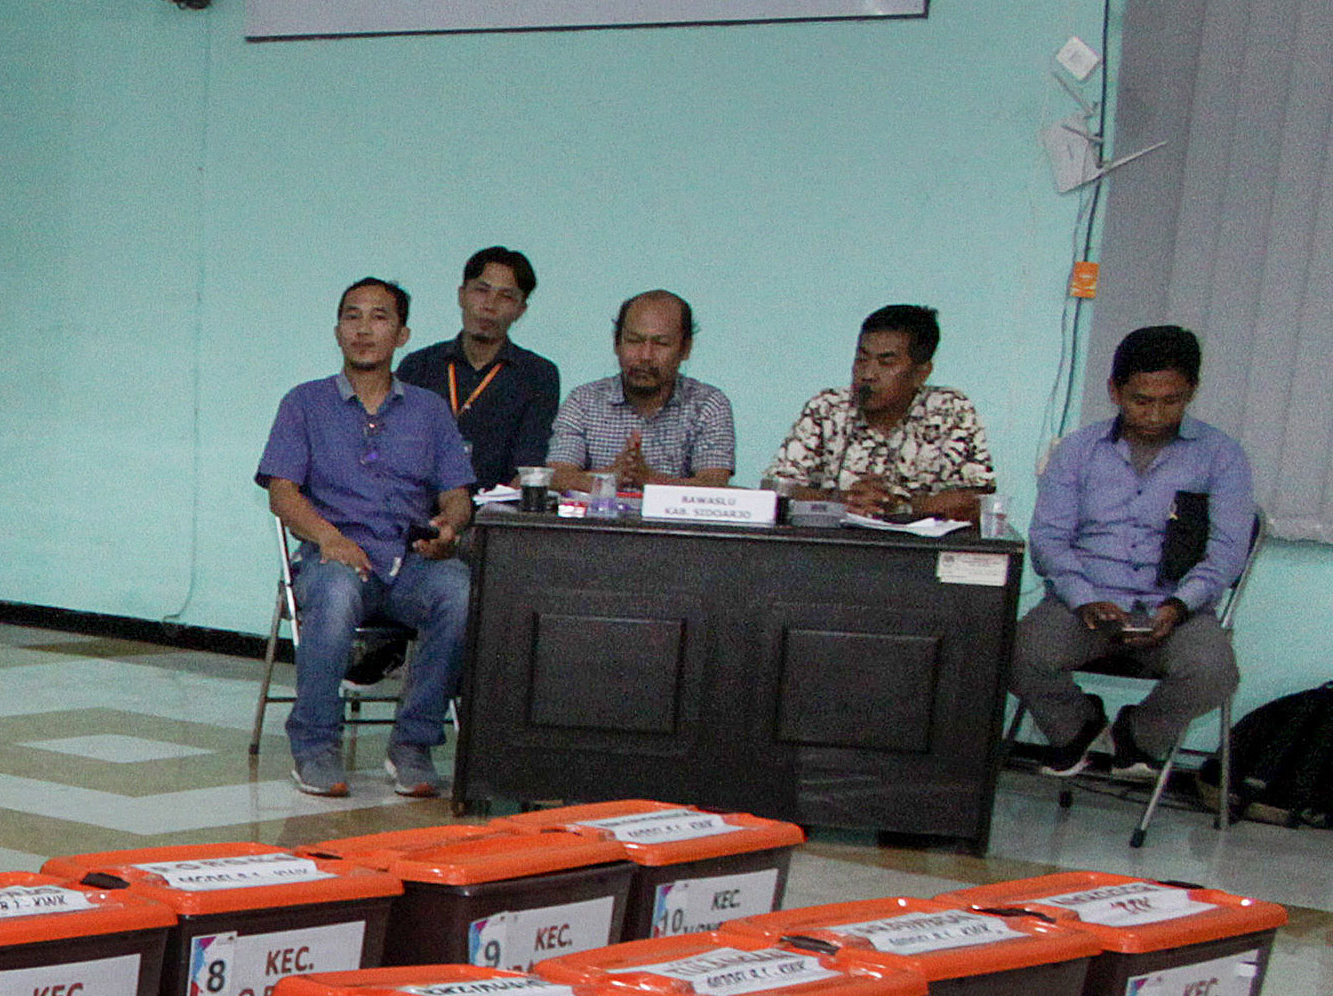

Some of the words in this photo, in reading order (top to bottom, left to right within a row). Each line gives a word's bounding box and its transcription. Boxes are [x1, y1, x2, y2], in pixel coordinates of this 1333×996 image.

[660, 907, 682, 934] 10
[535, 924, 573, 952] KEC.
[265, 946, 315, 976] KEC.
[485, 940, 501, 967] 9
[207, 960, 226, 993] 8
